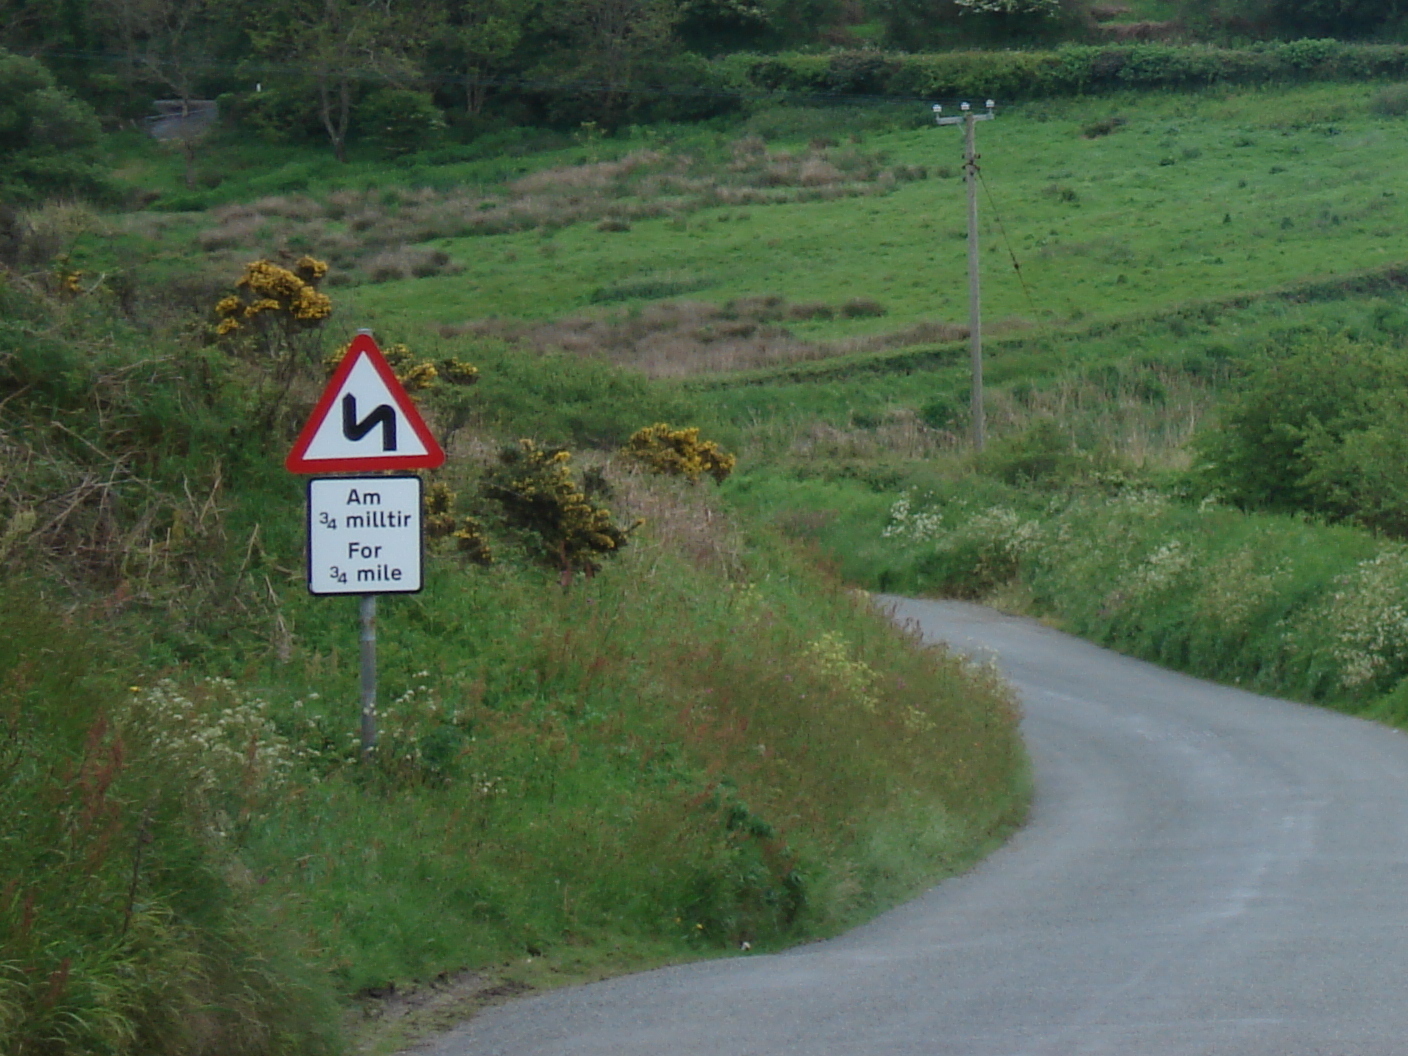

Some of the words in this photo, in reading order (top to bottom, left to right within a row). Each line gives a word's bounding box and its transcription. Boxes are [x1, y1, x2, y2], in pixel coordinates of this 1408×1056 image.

[347, 489, 381, 505] Am
[346, 511, 411, 528] milltir
[348, 542, 382, 559] For
[357, 564, 402, 582] mile
